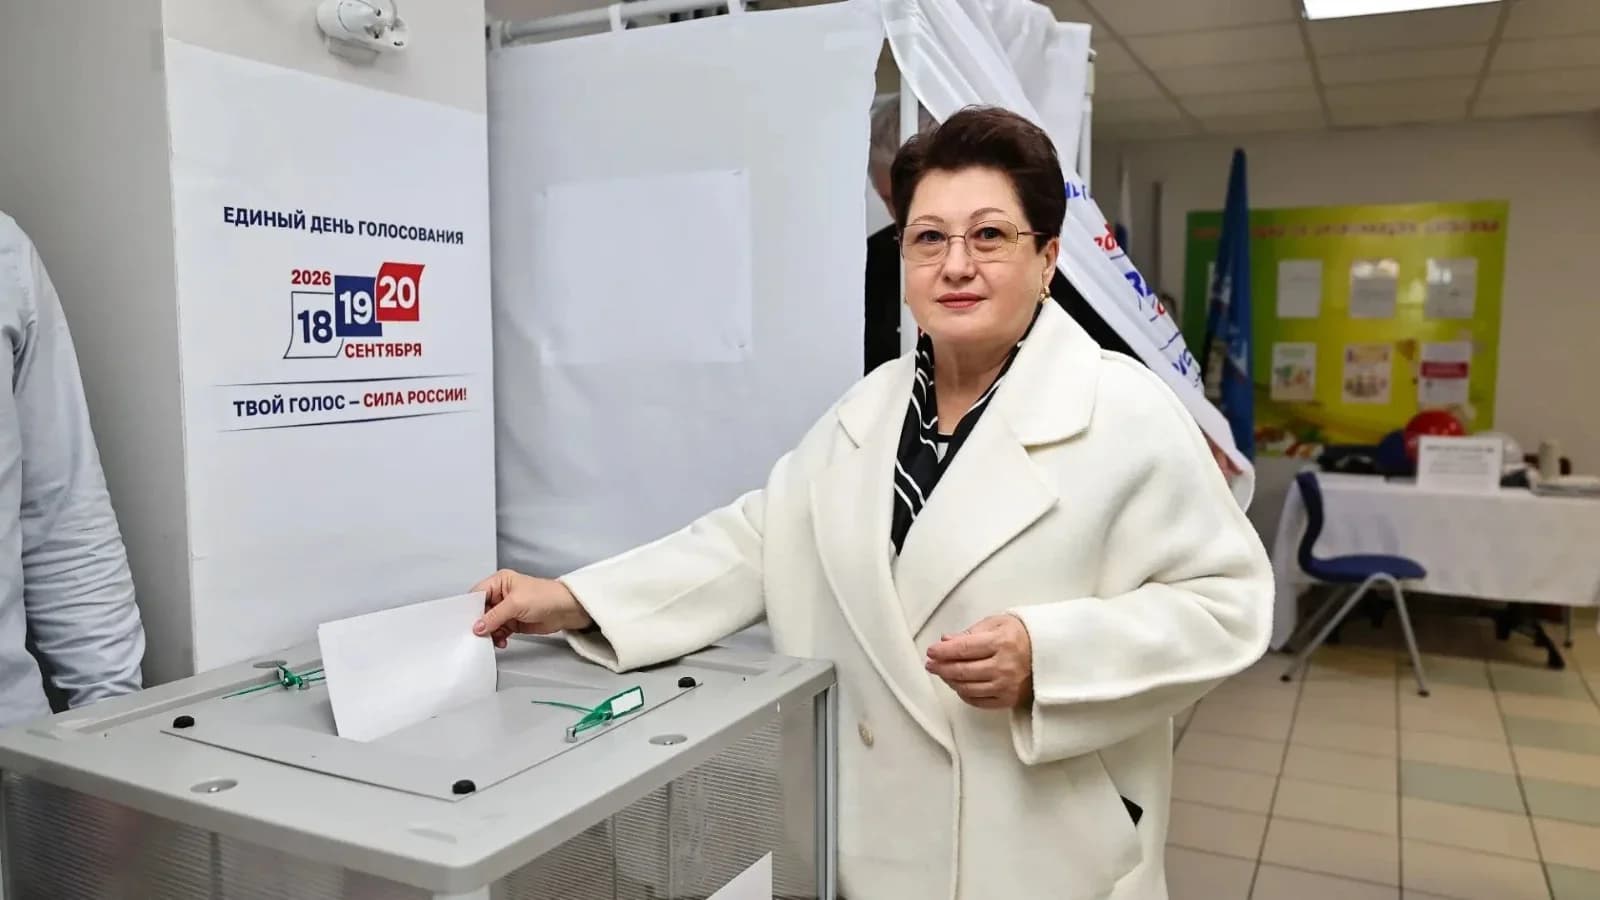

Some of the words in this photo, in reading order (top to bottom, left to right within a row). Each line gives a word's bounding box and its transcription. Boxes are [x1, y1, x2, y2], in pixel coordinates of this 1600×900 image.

[224, 206, 306, 230] ЕДИНЫЙ
[311, 216, 354, 235] ДЕНЬ
[359, 221, 464, 245] ГОЛОСОВАНИЯ
[291, 269, 331, 285] 2026
[297, 310, 333, 343] 18
[340, 291, 373, 325] 19
[379, 276, 416, 309] 20
[345, 343, 421, 358] СЕНТЯБРЯ
[234, 395, 284, 417] ТВОЙ
[290, 395, 345, 412] ГОЛОС
[364, 391, 404, 407] СИЛА
[408, 388, 467, 404] РОССИИ!
